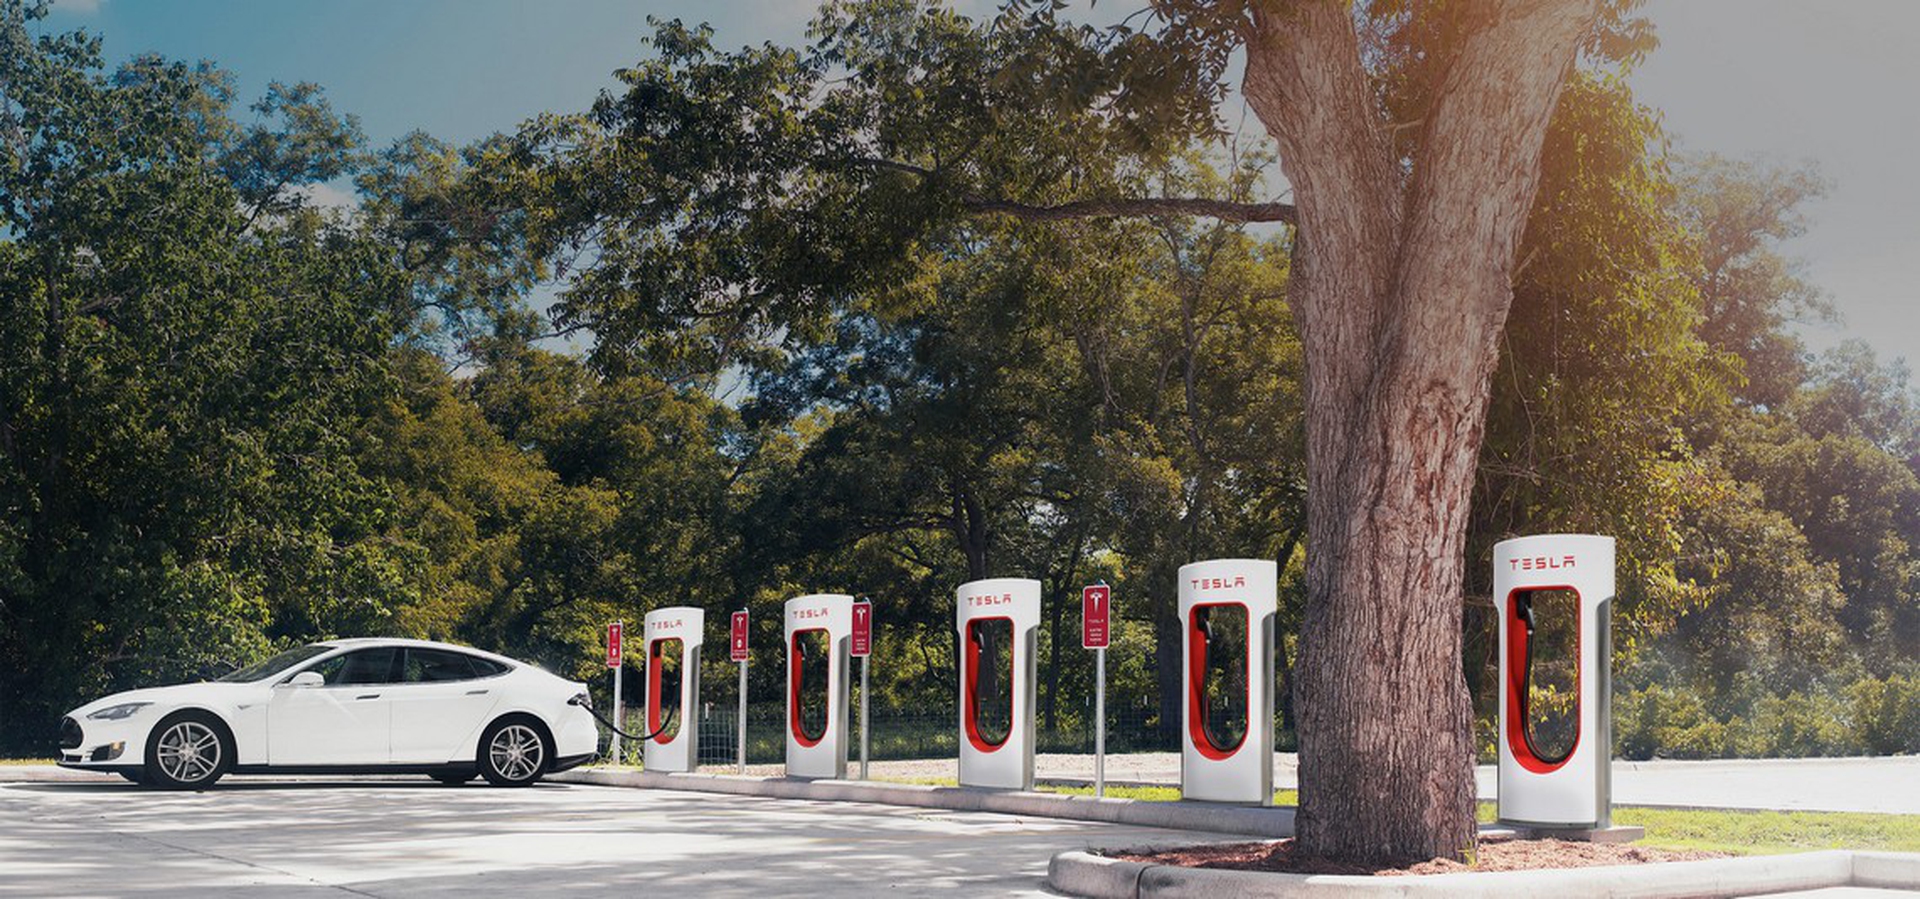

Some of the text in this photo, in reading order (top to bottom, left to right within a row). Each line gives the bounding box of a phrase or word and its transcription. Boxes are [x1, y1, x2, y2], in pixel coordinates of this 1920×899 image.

[1509, 555, 1575, 571] TESLA
[1191, 576, 1245, 590] TESLA
[967, 593, 1012, 606] TESLA
[793, 607, 829, 618] TESLA
[651, 619, 682, 629] TESLA
